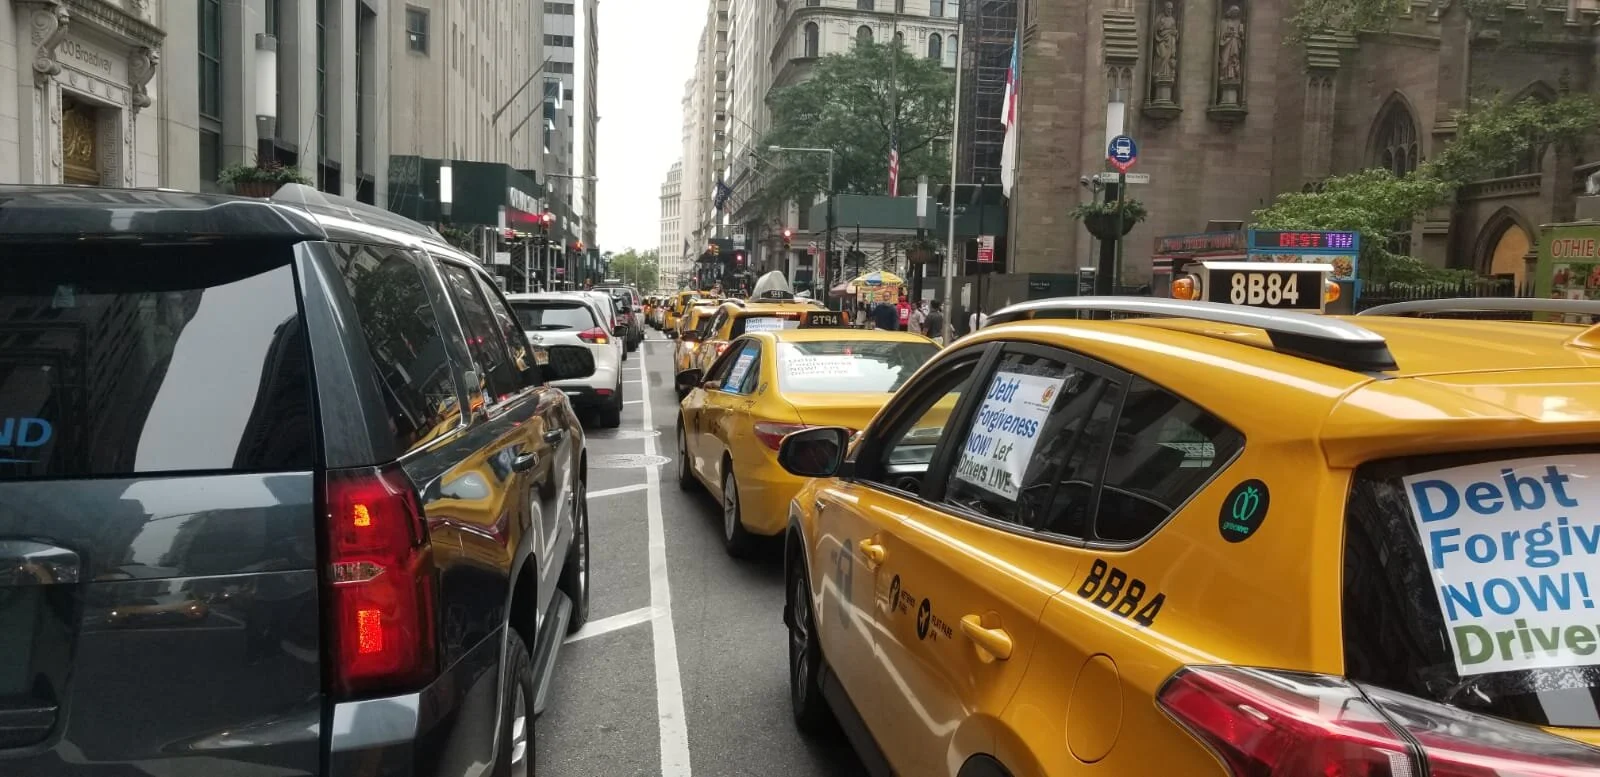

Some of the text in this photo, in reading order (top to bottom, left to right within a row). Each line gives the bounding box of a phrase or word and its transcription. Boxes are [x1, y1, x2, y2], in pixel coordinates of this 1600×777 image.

[75, 43, 112, 75] Broadway
[1279, 233, 1321, 247] BEST
[1552, 239, 1595, 257] OTHIE
[1230, 272, 1299, 305] 8B84
[812, 315, 838, 325] 2T94
[987, 376, 1021, 404] Debt
[976, 404, 1039, 439] Forgiveness
[967, 432, 1014, 462] NOW! Let
[957, 453, 1013, 494] Drivers LIVE.
[1411, 465, 1579, 524] Debt
[1076, 558, 1166, 628] 8B84
[1440, 571, 1595, 621] NOW!
[1453, 618, 1600, 666] Drive
